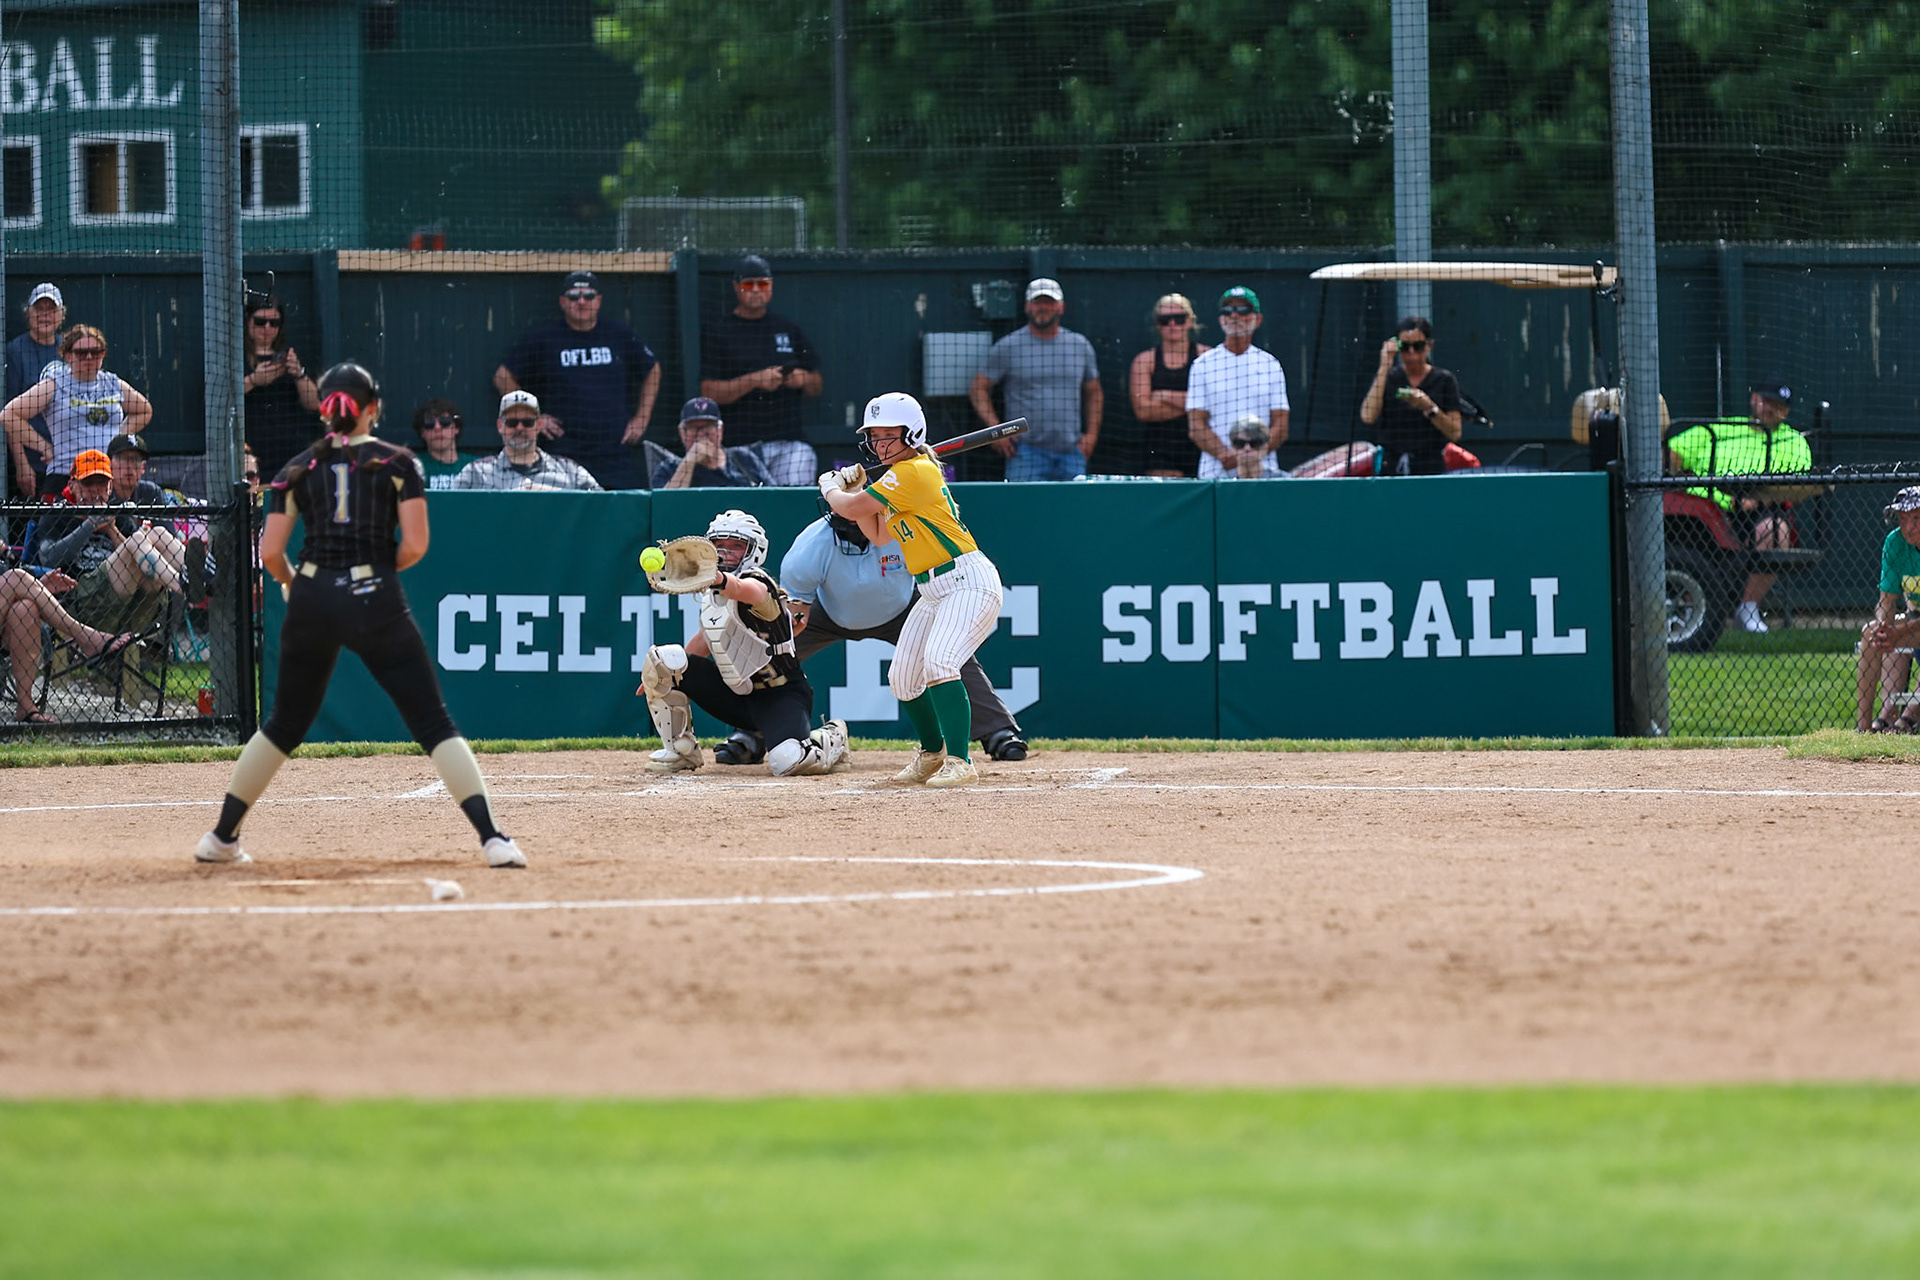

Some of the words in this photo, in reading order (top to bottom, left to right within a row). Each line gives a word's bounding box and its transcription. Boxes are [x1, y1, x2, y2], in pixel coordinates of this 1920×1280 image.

[893, 518, 915, 543] 14
[437, 593, 702, 672] CELTI
[1102, 577, 1587, 662] SOFTBALL
